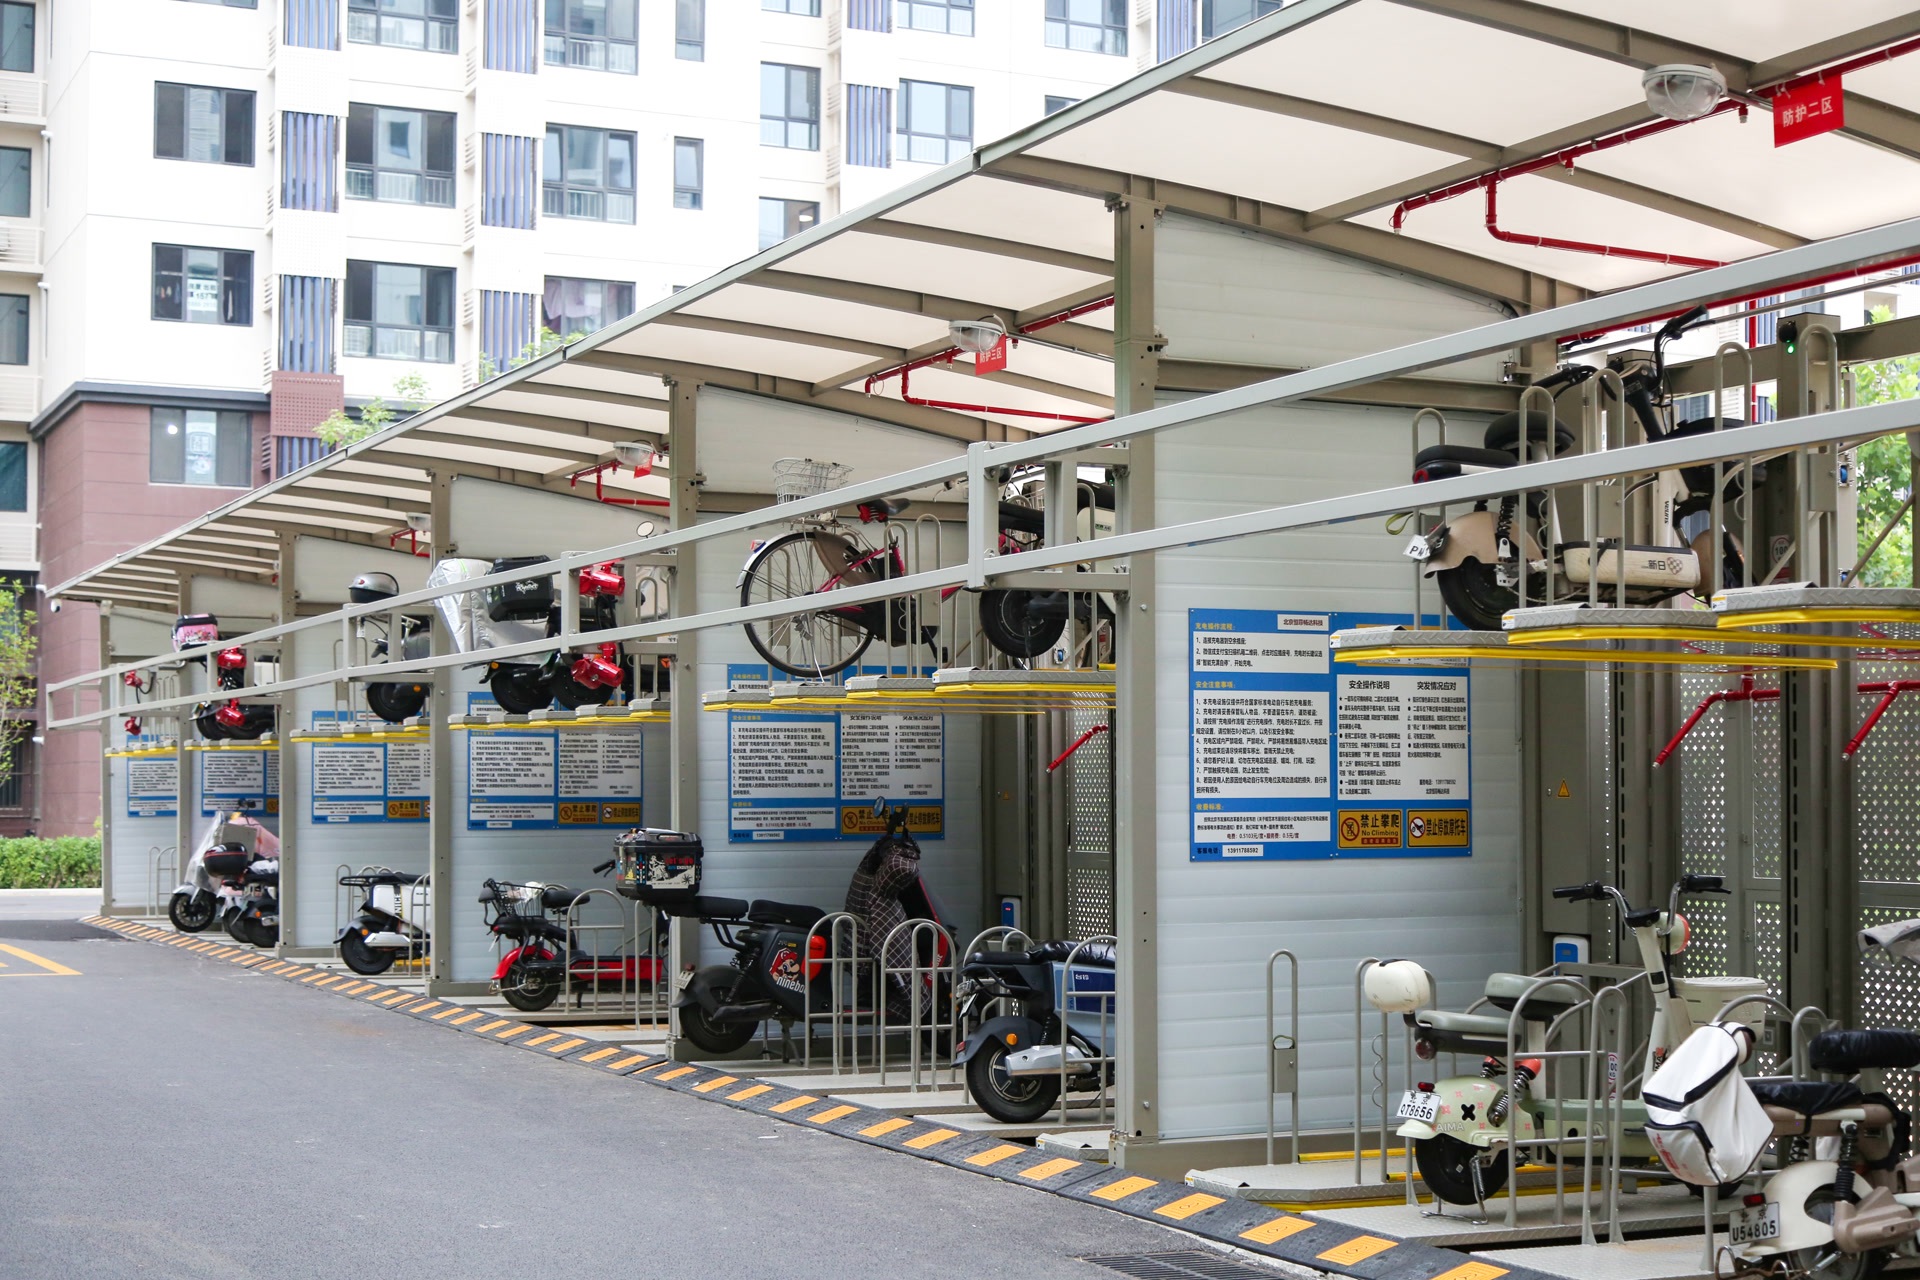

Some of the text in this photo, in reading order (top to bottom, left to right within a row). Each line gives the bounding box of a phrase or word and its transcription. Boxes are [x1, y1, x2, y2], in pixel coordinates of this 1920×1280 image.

[1782, 95, 1833, 127] 防护二区
[1349, 680, 1390, 690] 安全操作说明
[1417, 681, 1457, 691] 突发情况应对
[1360, 813, 1400, 828] 禁止攀爬
[1426, 817, 1466, 837] 禁止停放摩托车
[1371, 829, 1399, 837] Climbing
[776, 975, 806, 994] ninebo
[1400, 1103, 1434, 1120] QT8656
[1436, 1122, 1465, 1132] AIMA
[1732, 1219, 1777, 1242] U54805
